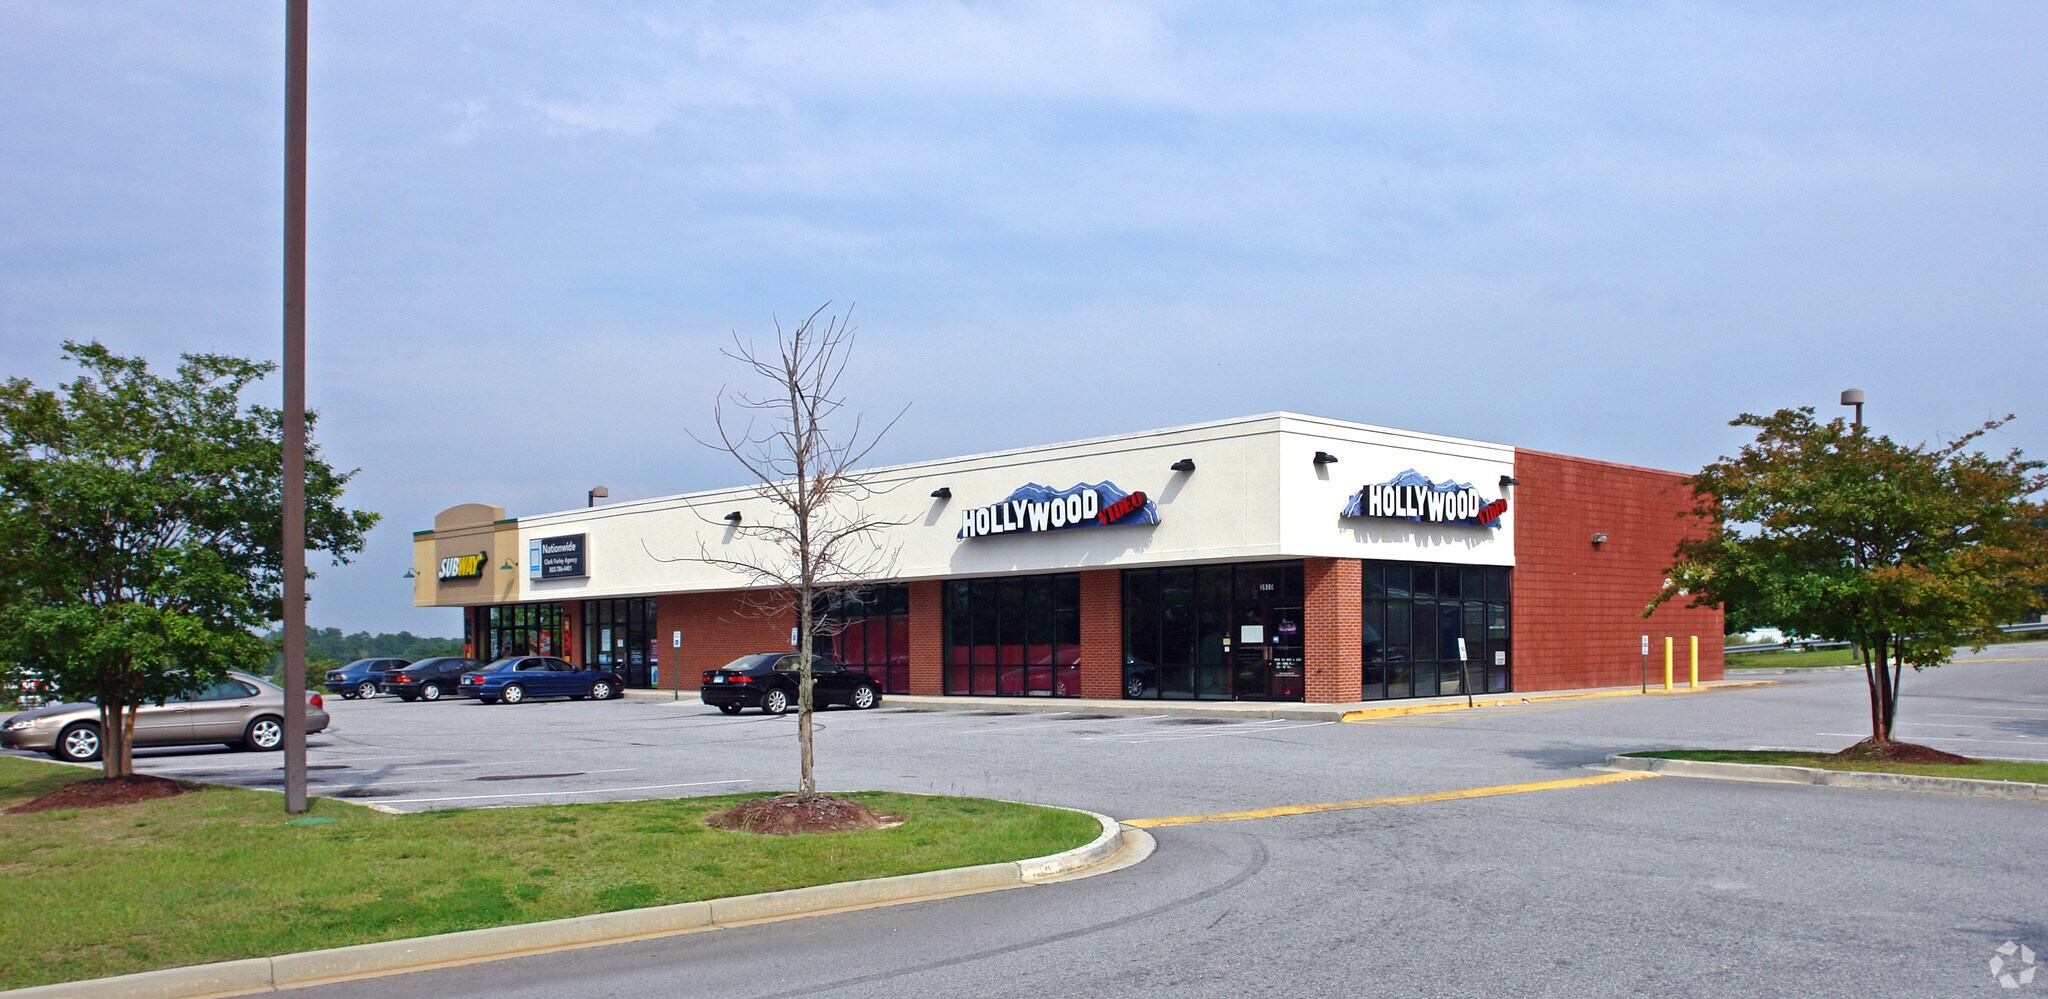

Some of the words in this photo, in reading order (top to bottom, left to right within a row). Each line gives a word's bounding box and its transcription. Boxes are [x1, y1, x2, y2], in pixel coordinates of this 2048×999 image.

[962, 489, 1099, 537] HOLLYWOOD
[1098, 491, 1144, 526] VIDEO
[1369, 484, 1479, 522] HOLLYWOOD
[1478, 498, 1508, 525] VIDEO
[542, 541, 576, 554] Nationwide
[438, 554, 482, 578] SUBWAY
